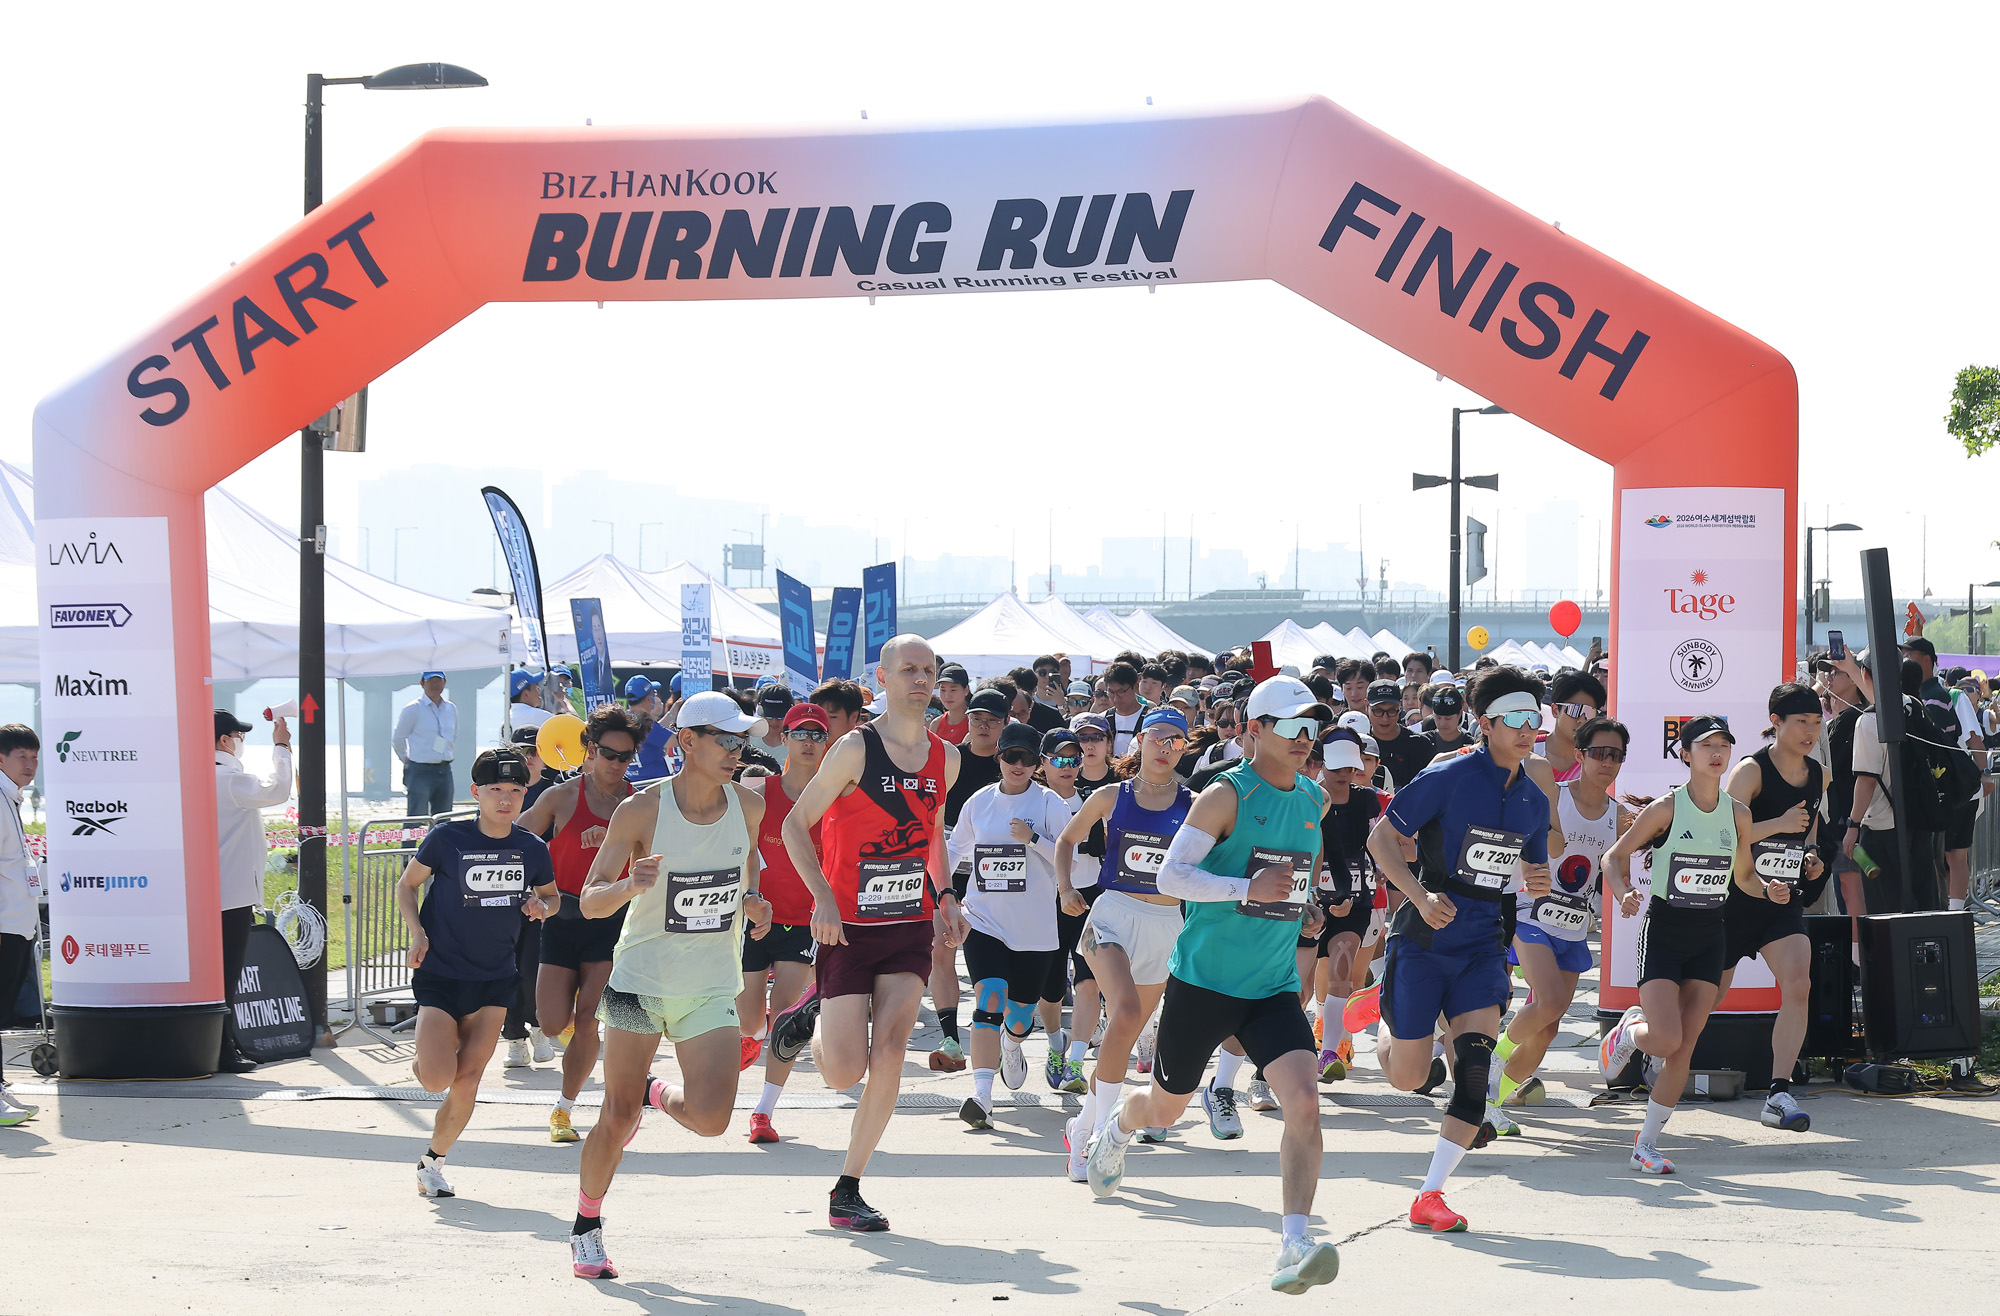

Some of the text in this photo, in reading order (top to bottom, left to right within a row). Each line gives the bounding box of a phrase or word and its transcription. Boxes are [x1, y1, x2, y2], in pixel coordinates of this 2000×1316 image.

[522, 189, 1195, 282] BURNING RUN
[857, 267, 1178, 291] Casual Running Festival
[1318, 181, 1651, 402] FINISH
[127, 211, 389, 426] START
[1676, 514, 1756, 525] 2026여수세계섬박람회
[1663, 588, 1735, 621] Tage
[54, 609, 117, 623] FAVONEX
[682, 617, 710, 647] 정근식
[1677, 641, 1717, 658] SUNBODY
[682, 657, 711, 678] 민주진보
[55, 670, 129, 697] Maxim
[1680, 677, 1714, 690] TANNING
[71, 750, 138, 762] NEWTREE
[881, 775, 938, 794] 김 포
[66, 800, 128, 816] Reebok
[1131, 852, 1165, 865] W 79
[1473, 850, 1519, 866] M 7207
[1761, 857, 1800, 869] M 7139
[982, 861, 1025, 872] W 7637
[472, 870, 523, 882] M 7166
[1481, 877, 1499, 885] A-19
[1681, 874, 1727, 886] W 7808
[872, 877, 922, 893] M 7160
[1293, 877, 1308, 892] 10
[681, 888, 738, 907] M 7247
[858, 894, 882, 902] D-229
[694, 918, 716, 927] A-87
[1543, 908, 1585, 924] M 7190
[84, 943, 151, 957] 롯데웰푸드
[237, 966, 261, 994] ART
[234, 996, 306, 1030] WAITING LINE
